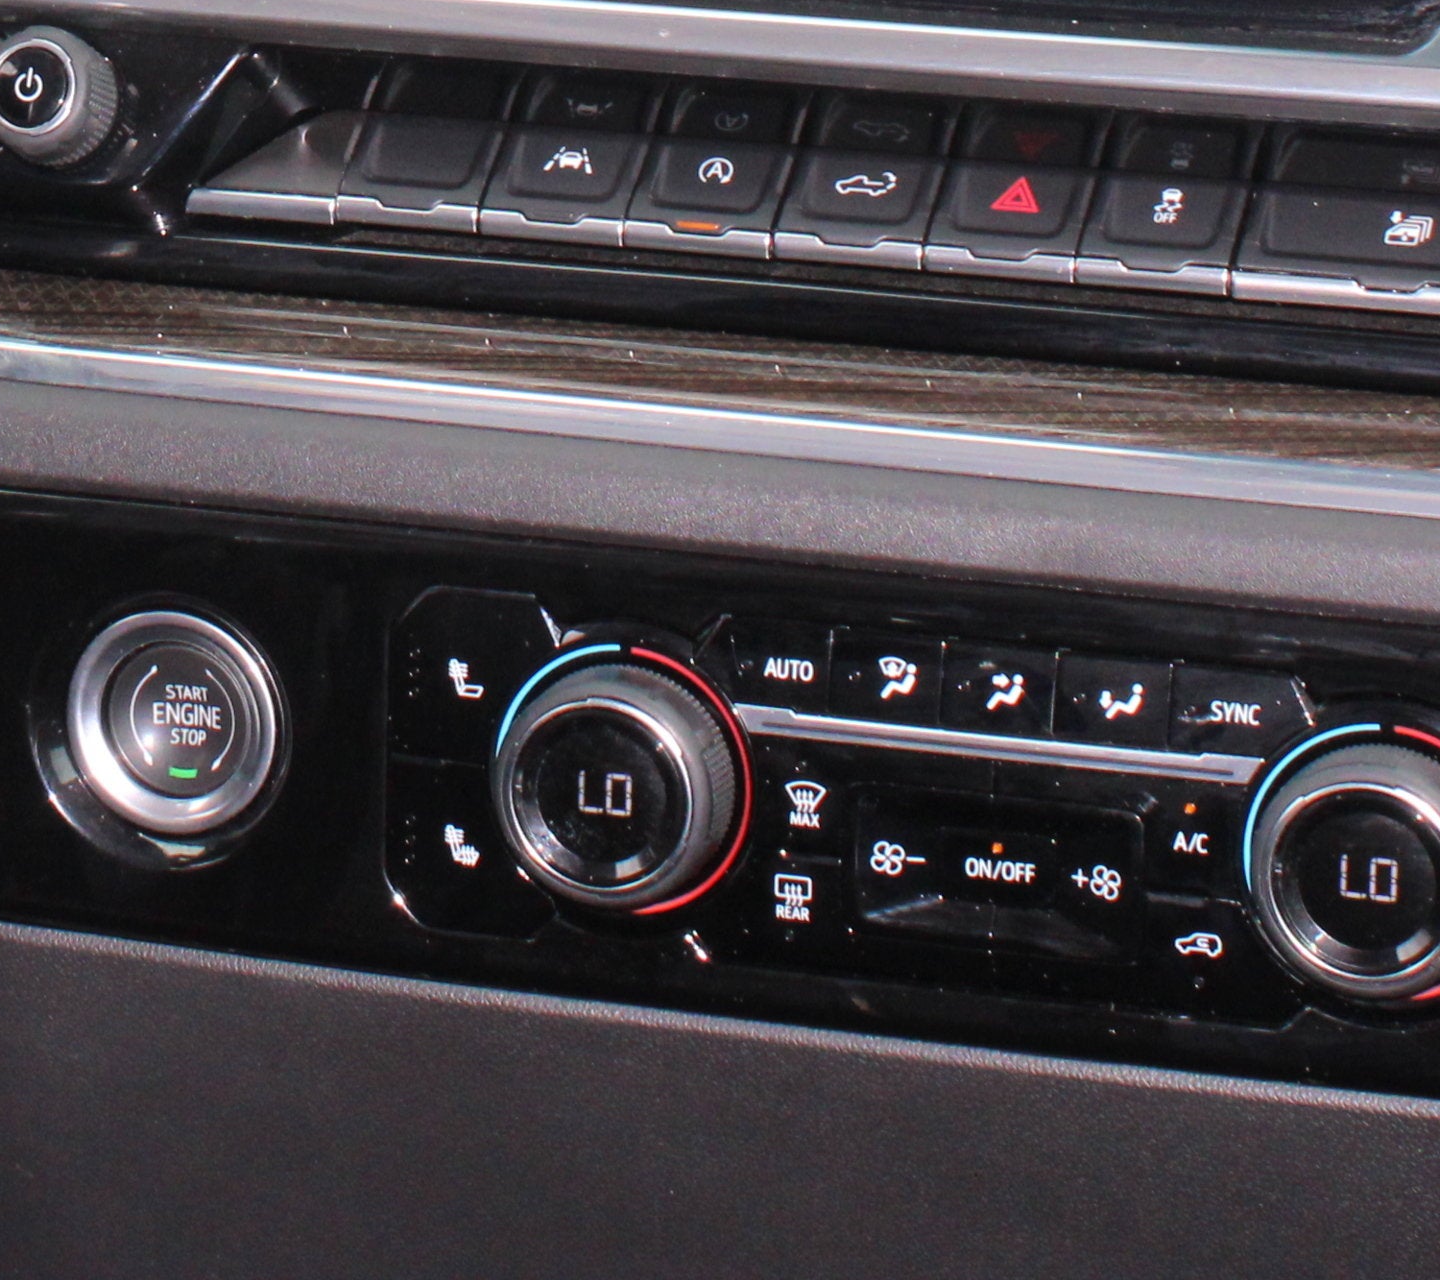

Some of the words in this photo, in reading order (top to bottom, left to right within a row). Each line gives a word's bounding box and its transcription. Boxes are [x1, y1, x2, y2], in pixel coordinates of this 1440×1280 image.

[1153, 212, 1177, 224] OFF
[764, 657, 814, 682] AUTO
[165, 684, 208, 702] START
[153, 702, 221, 729] ENGINE
[1210, 700, 1261, 726] SYNC
[170, 728, 206, 746] STOP
[789, 811, 820, 829] MAX
[1173, 831, 1209, 855] A/C
[965, 857, 1036, 884] ON/OFF
[775, 905, 810, 922] REAR
